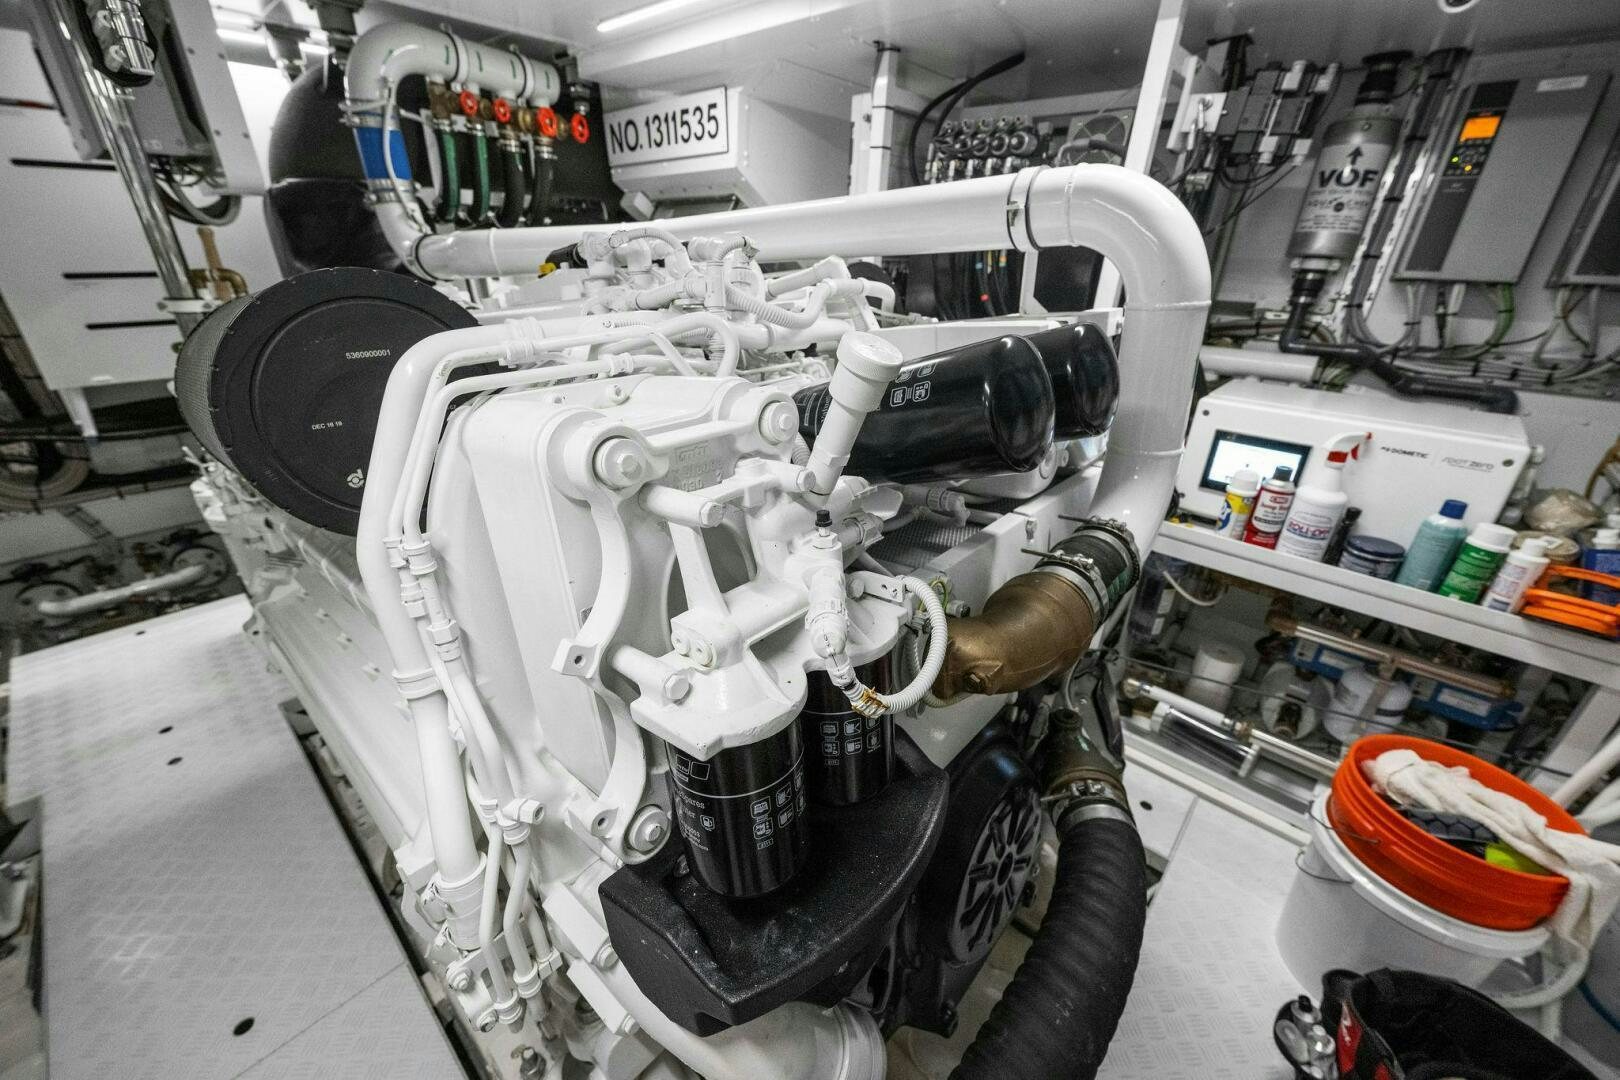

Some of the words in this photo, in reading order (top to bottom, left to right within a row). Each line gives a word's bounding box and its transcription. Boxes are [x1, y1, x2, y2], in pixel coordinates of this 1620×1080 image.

[609, 103, 719, 154] NO.1311535
[1319, 169, 1379, 188] VOF
[1391, 448, 1429, 459] DOMETIC
[1287, 520, 1331, 537] ROLL-OFF
